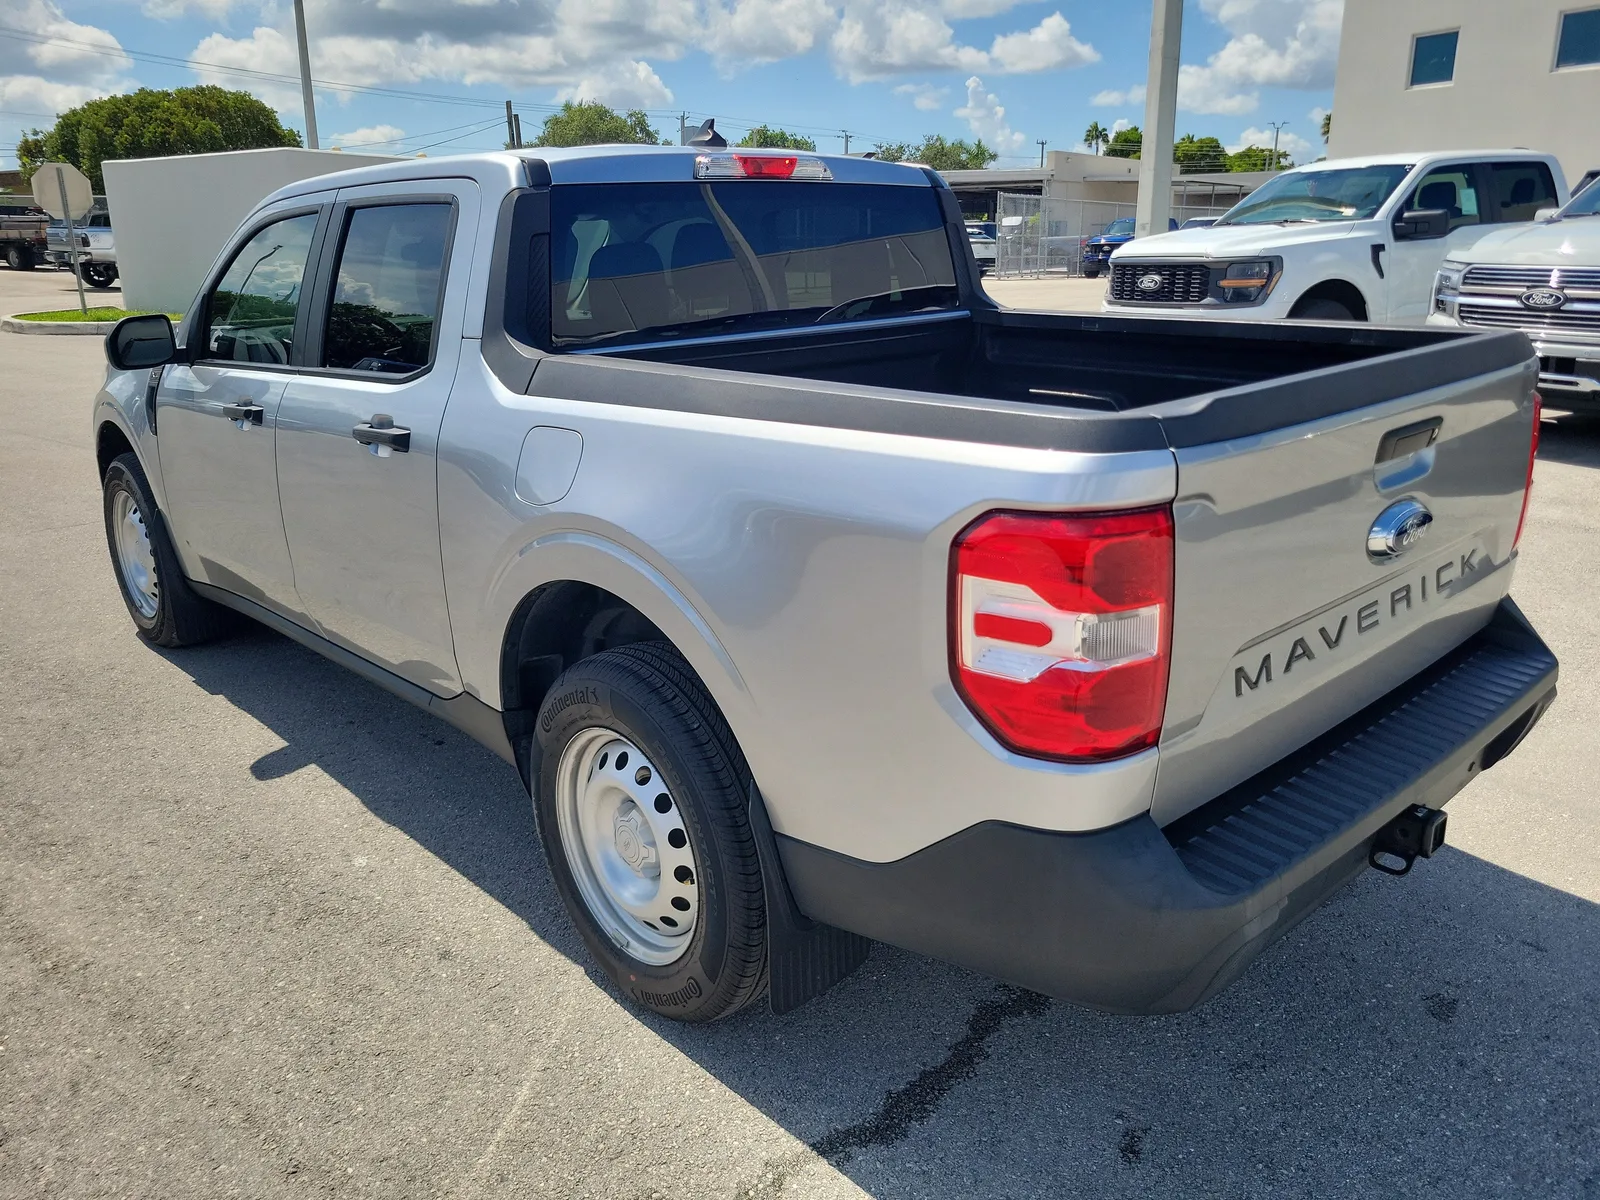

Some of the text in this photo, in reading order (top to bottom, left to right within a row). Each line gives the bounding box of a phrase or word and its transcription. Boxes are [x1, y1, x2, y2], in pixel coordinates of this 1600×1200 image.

[1529, 292, 1556, 305] Ford
[1402, 519, 1428, 546] Ford
[1233, 548, 1478, 698] MAVERICK
[541, 686, 590, 733] Continental
[641, 976, 703, 1007] Continental
